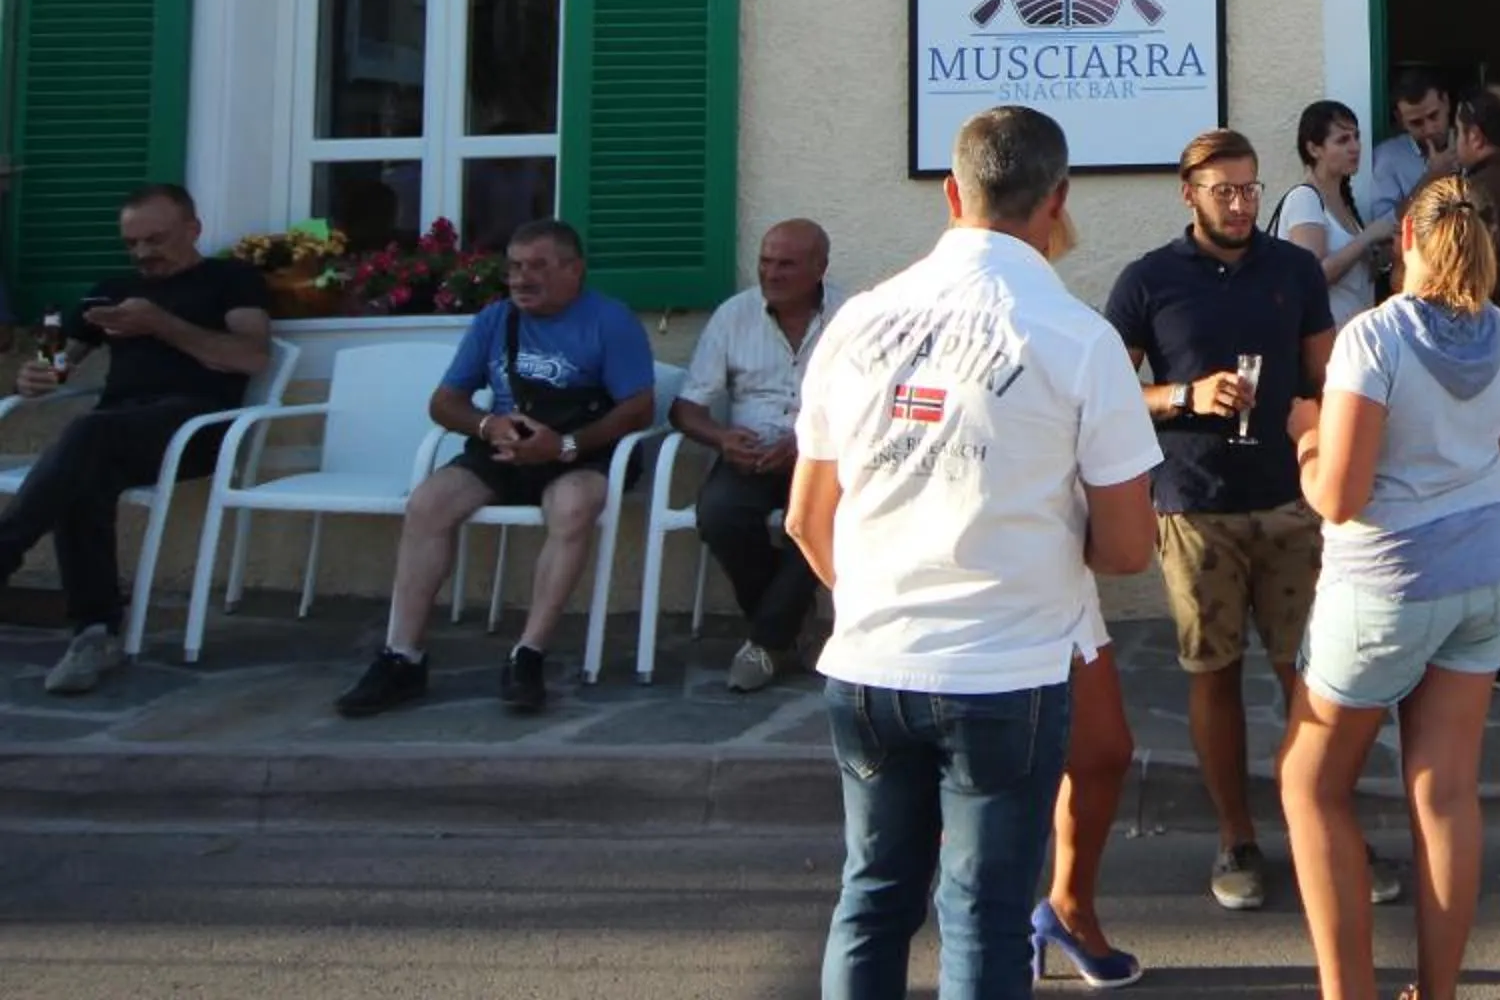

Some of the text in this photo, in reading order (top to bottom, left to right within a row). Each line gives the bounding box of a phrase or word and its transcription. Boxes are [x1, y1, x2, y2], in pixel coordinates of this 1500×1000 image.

[927, 41, 1207, 81] MUSCIARRA
[1000, 79, 1136, 101] SNACK BAR
